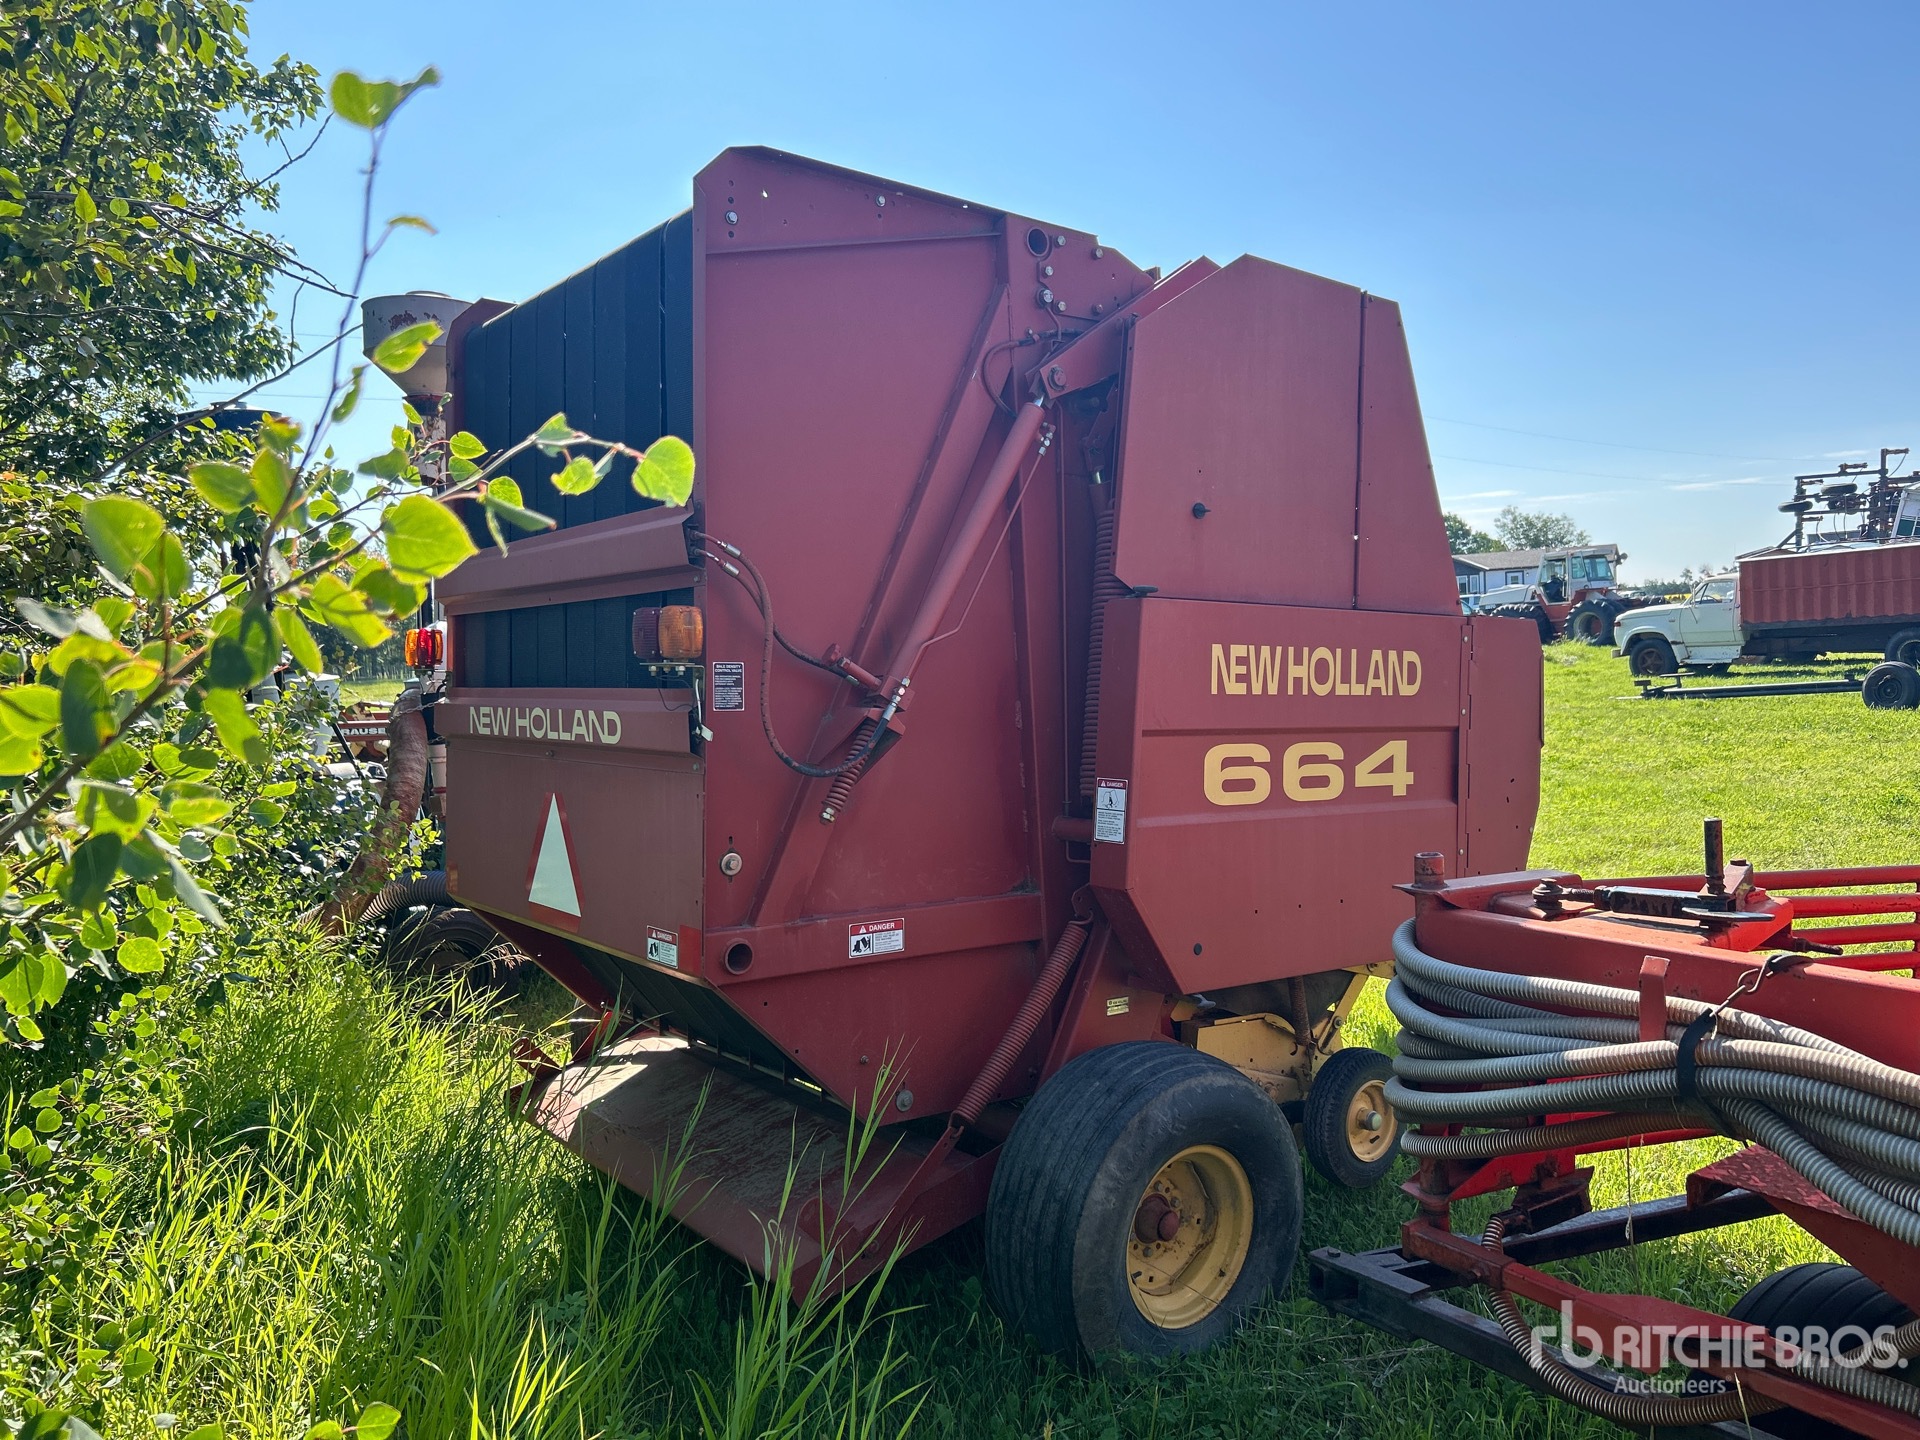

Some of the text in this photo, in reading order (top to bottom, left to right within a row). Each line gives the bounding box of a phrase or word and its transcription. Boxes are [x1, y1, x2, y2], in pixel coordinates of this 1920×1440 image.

[1211, 643, 1422, 696] NEW HOLLAND
[340, 727, 386, 736] RAUSE
[469, 706, 622, 745] NEW HOLLAND
[1203, 740, 1414, 806] 664
[869, 922, 895, 932] DANGER
